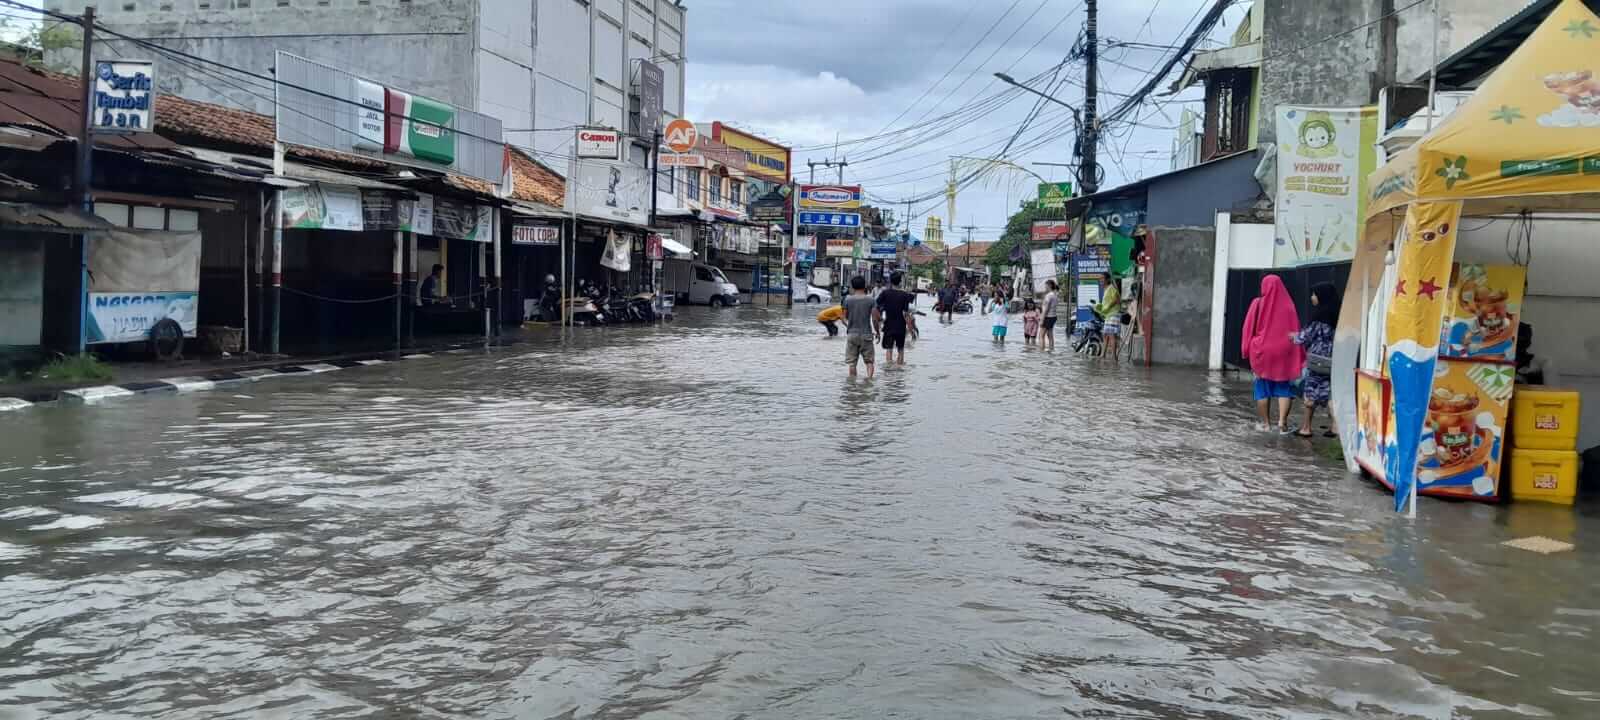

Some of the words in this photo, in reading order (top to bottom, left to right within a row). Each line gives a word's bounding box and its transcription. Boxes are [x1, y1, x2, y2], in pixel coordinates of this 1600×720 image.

[96, 91, 149, 110] Tambal
[102, 109, 140, 127] ban
[580, 132, 616, 142] Canon
[664, 127, 697, 145] AF
[1294, 163, 1342, 173] YOGHURT
[513, 227, 534, 240] FOTO
[537, 228, 559, 241] COPY
